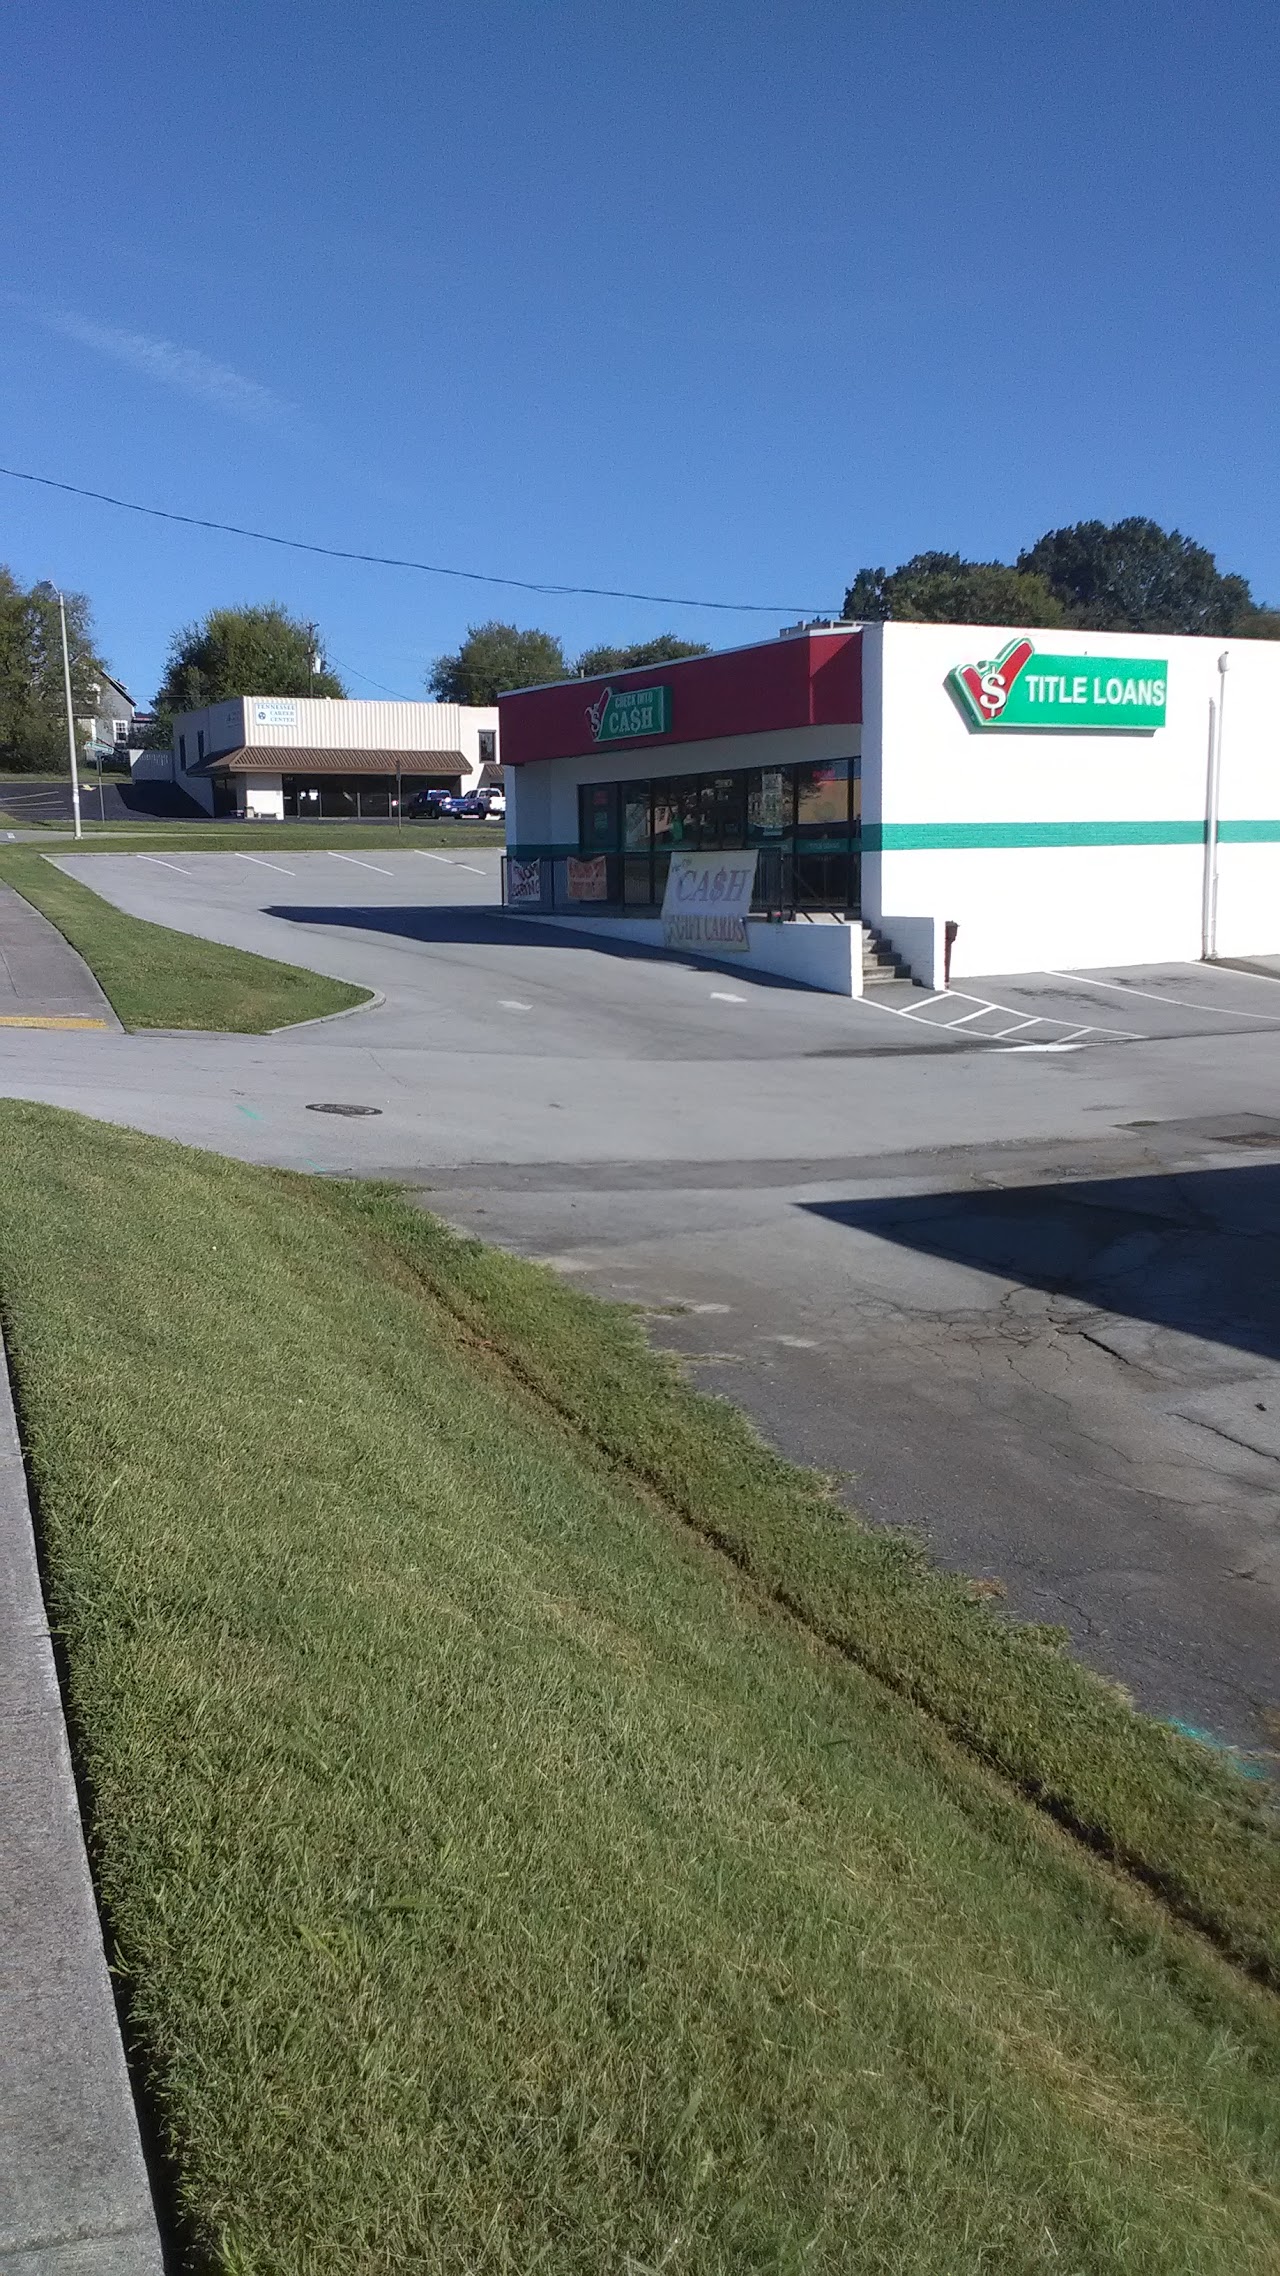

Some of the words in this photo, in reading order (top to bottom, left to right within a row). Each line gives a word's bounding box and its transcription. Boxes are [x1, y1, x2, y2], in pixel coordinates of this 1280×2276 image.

[614, 694, 636, 709] CHECK
[637, 691, 653, 705] INTO
[1025, 675, 1087, 704] TITLE
[1093, 677, 1166, 706] LOANS
